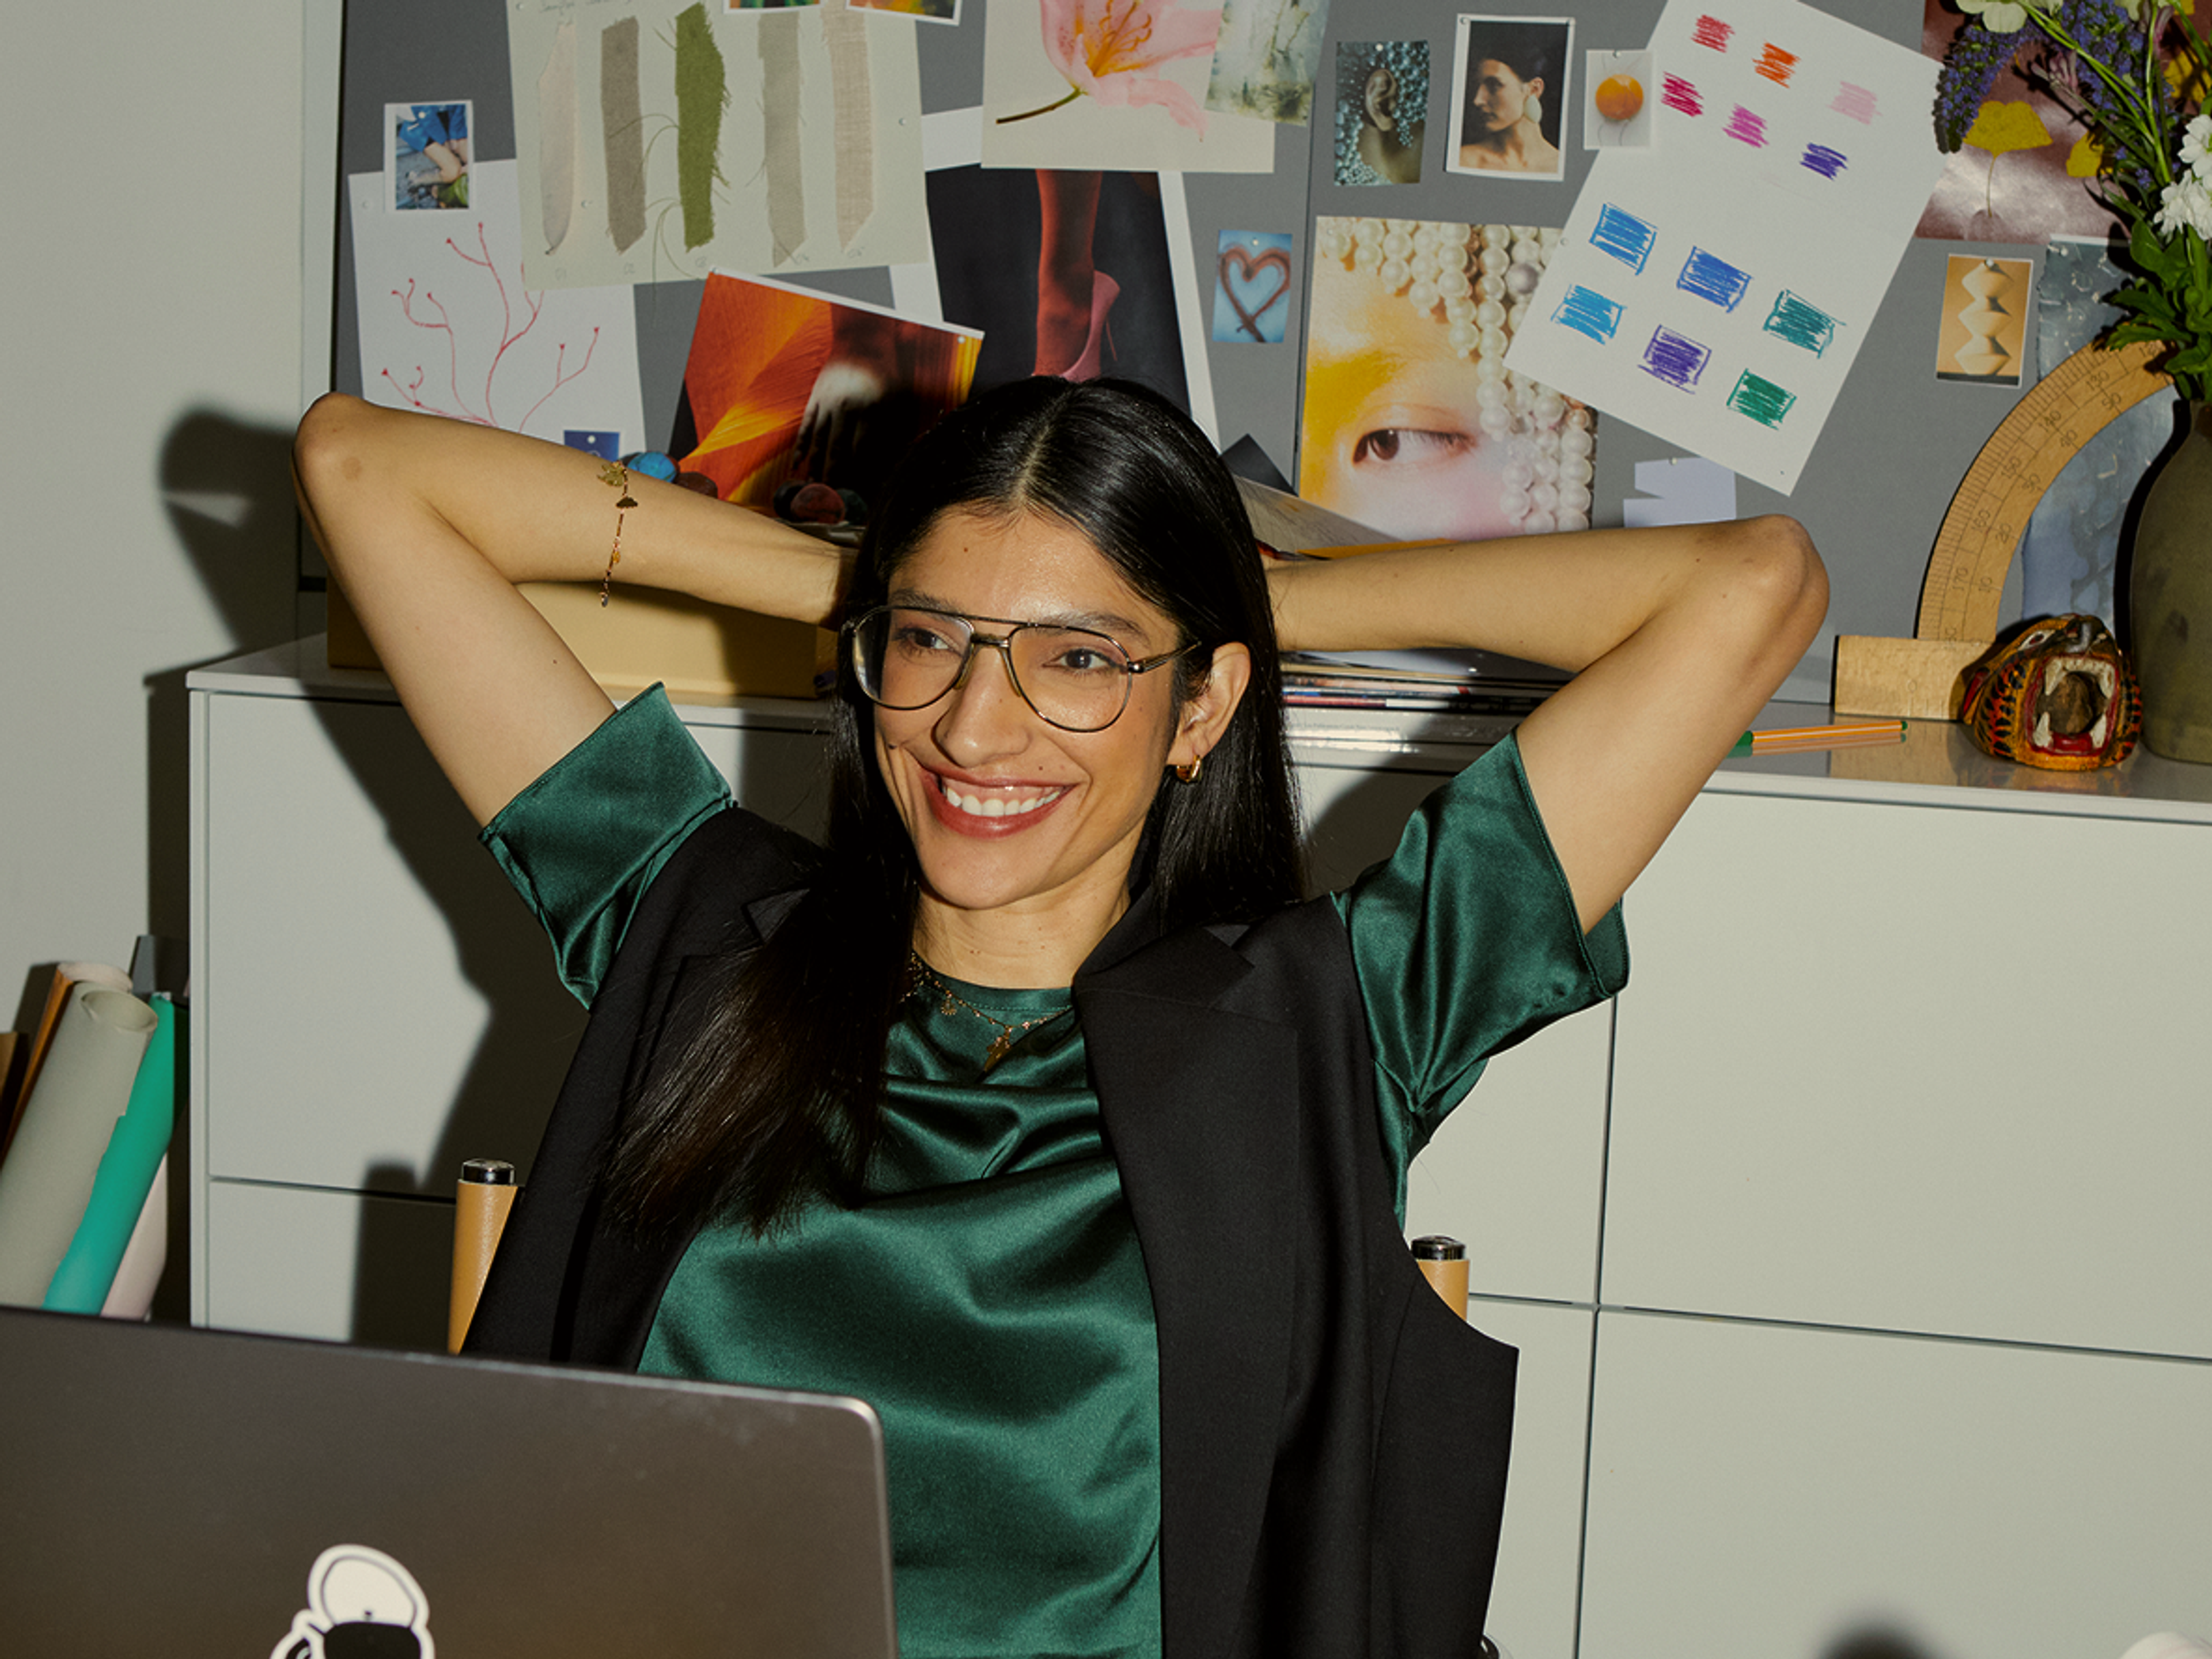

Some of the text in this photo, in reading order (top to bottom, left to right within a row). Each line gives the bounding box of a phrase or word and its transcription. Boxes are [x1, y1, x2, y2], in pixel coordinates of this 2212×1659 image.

[2086, 370, 2109, 391] 130
[2101, 392, 2122, 410] 50
[2038, 410, 2062, 433] 140
[2060, 429, 2078, 448] 40
[2001, 456, 2022, 479] 150
[2022, 474, 2041, 494] 30
[1971, 509, 1991, 533] 160
[1995, 522, 2012, 544] 20
[1952, 567, 1968, 591] 170
[1979, 576, 1993, 593] 10
